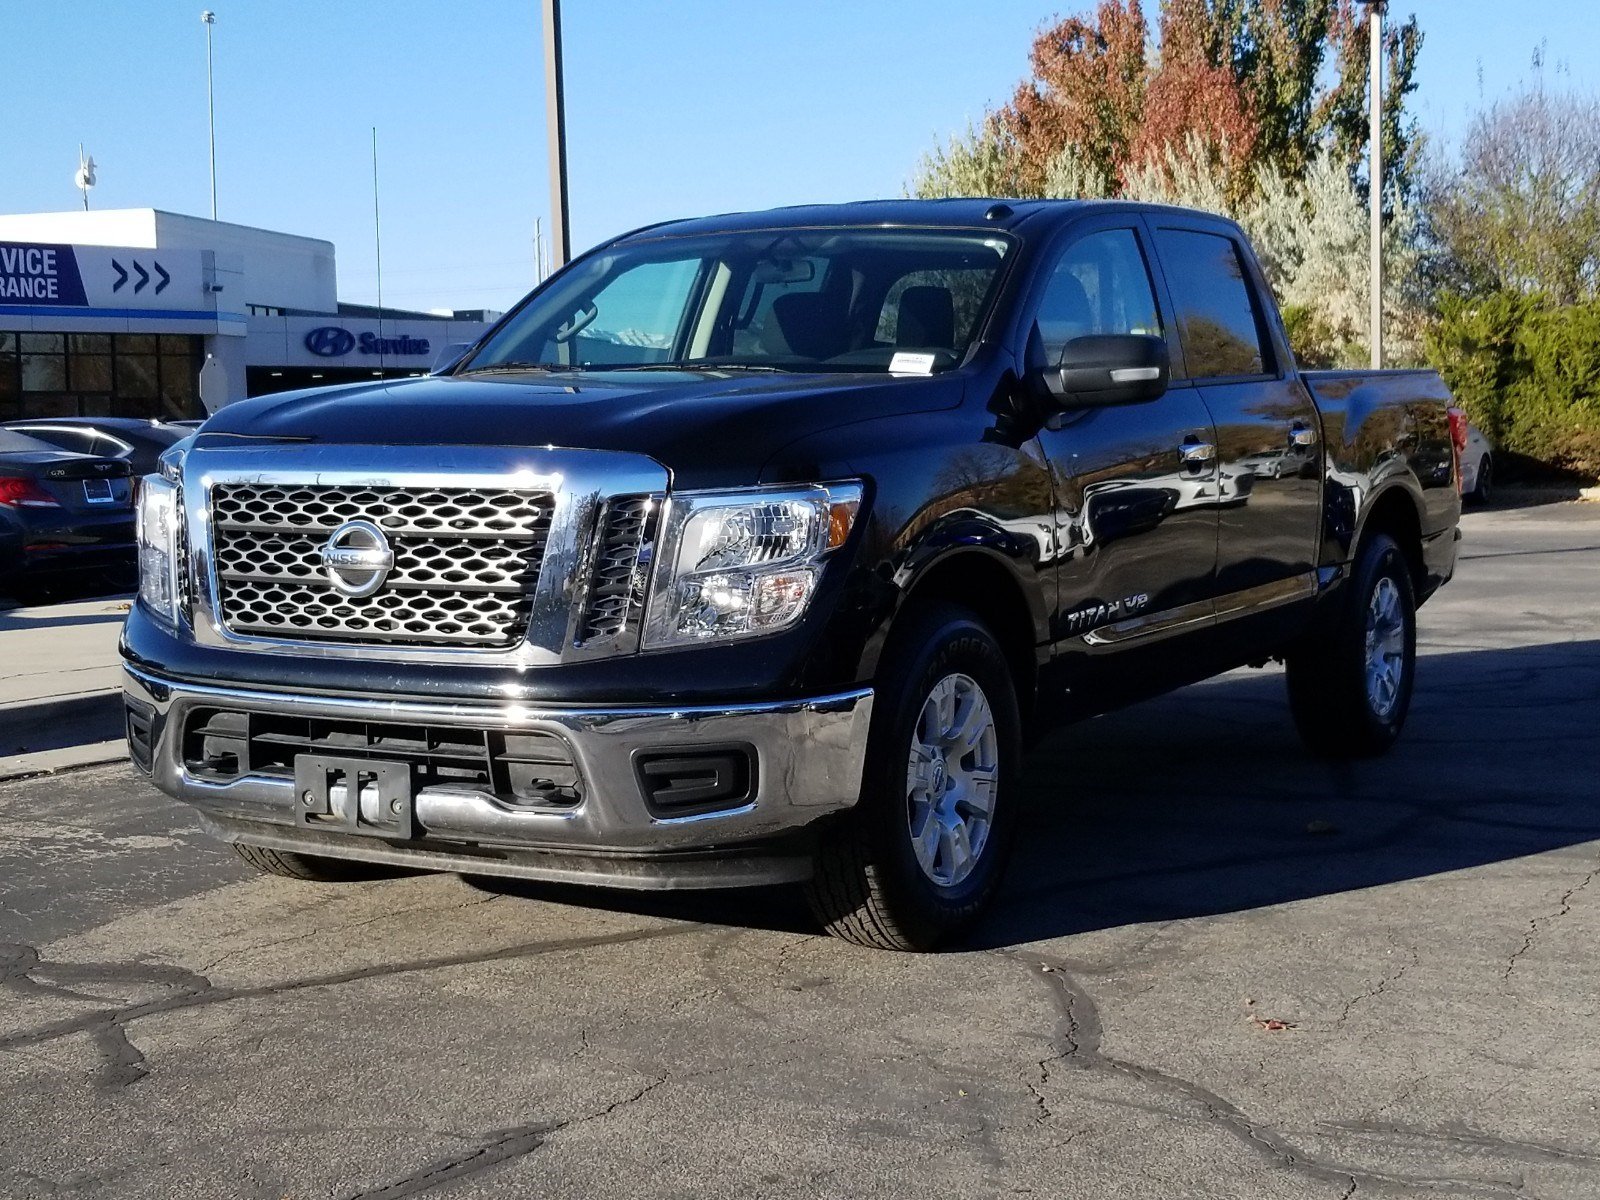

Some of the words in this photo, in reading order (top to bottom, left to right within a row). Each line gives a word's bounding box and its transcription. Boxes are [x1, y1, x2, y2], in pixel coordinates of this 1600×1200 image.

[0, 247, 58, 275] VICE
[358, 331, 430, 355] Service
[1067, 600, 1120, 631] TITAN
[1124, 593, 1149, 613] V8
